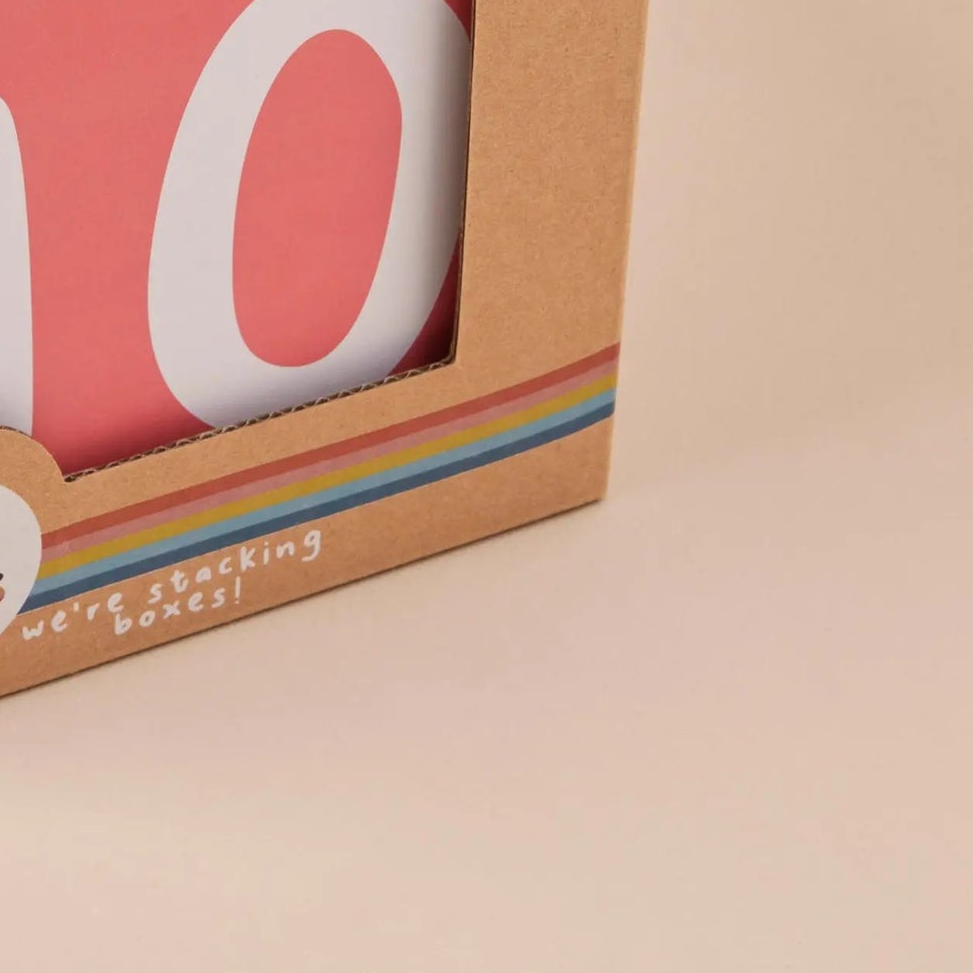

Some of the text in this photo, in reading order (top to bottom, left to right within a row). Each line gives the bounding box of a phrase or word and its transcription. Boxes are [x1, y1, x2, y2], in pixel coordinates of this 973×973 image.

[21, 528, 323, 642] we're stacking
[114, 578, 243, 636] boxes!
